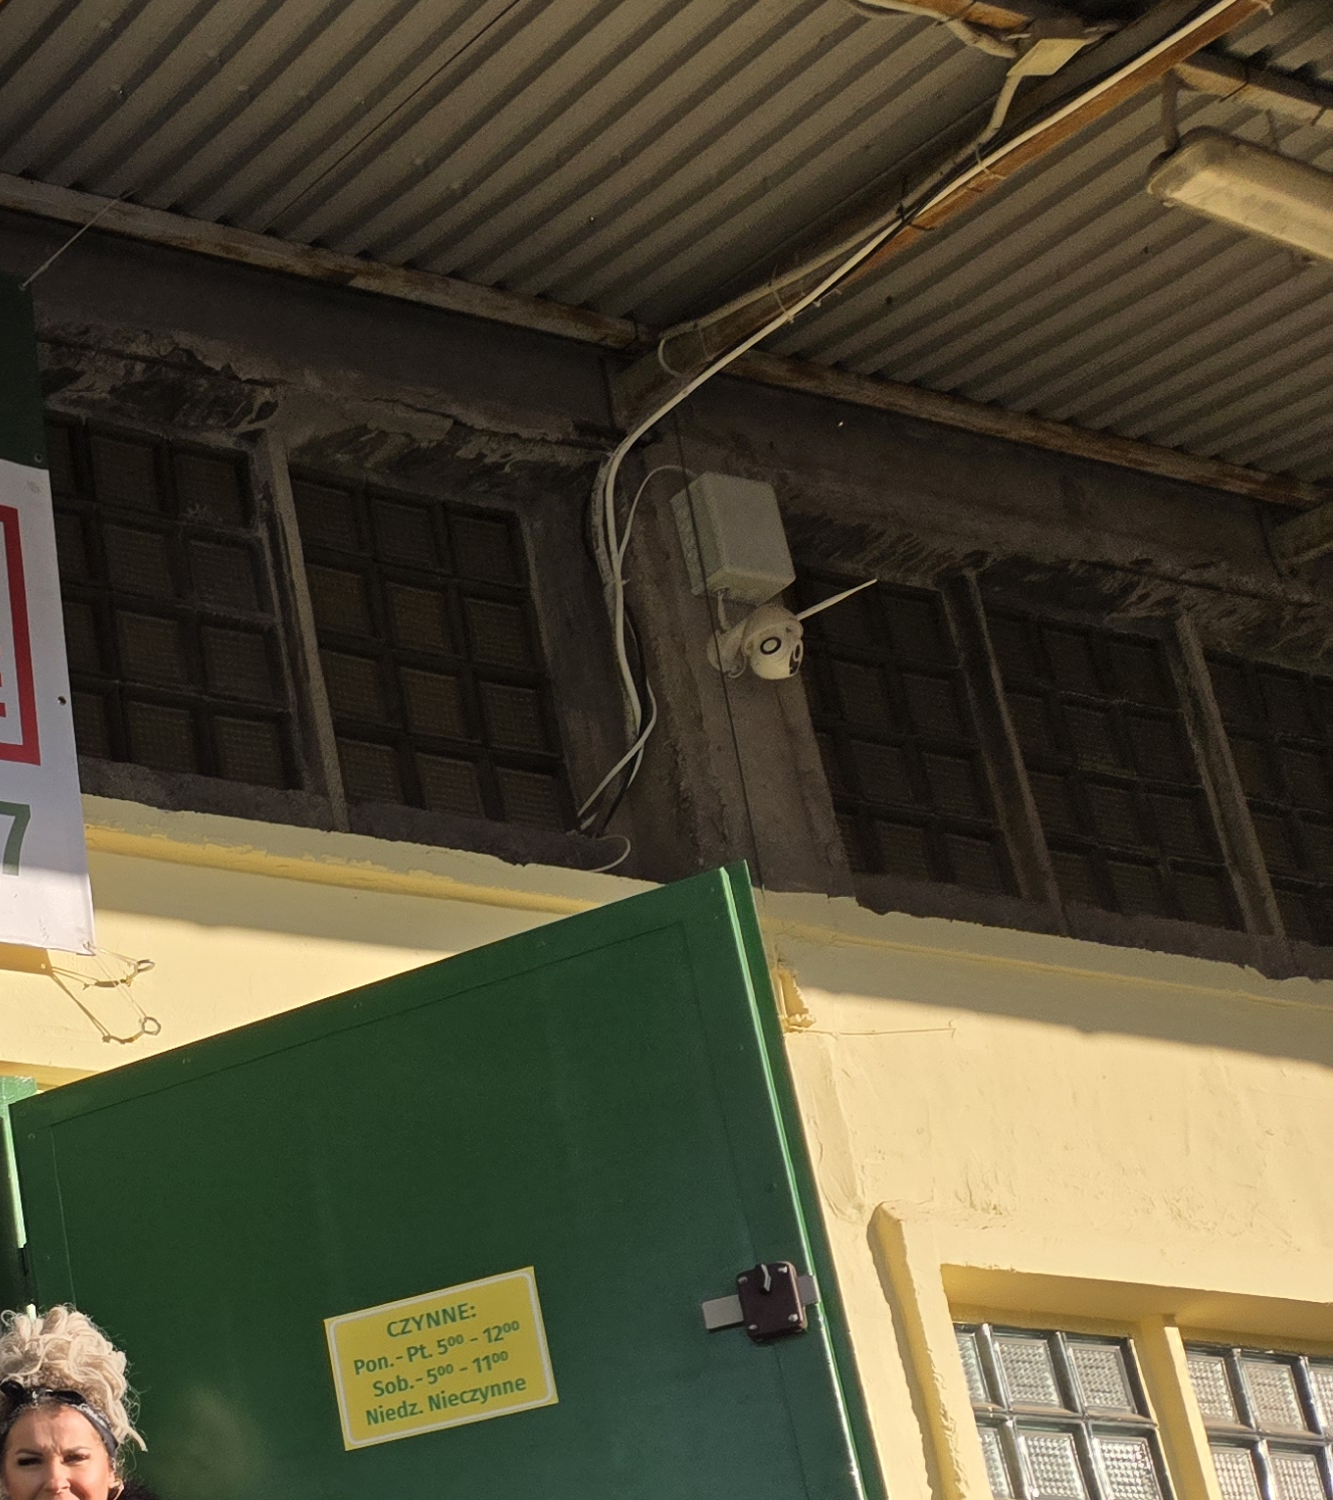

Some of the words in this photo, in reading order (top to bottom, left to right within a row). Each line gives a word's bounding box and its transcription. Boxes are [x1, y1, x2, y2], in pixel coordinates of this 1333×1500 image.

[387, 1303, 477, 1338] CZYNNE:
[365, 1400, 424, 1427] Niedz.
[428, 1376, 526, 1412] Nieczynne
